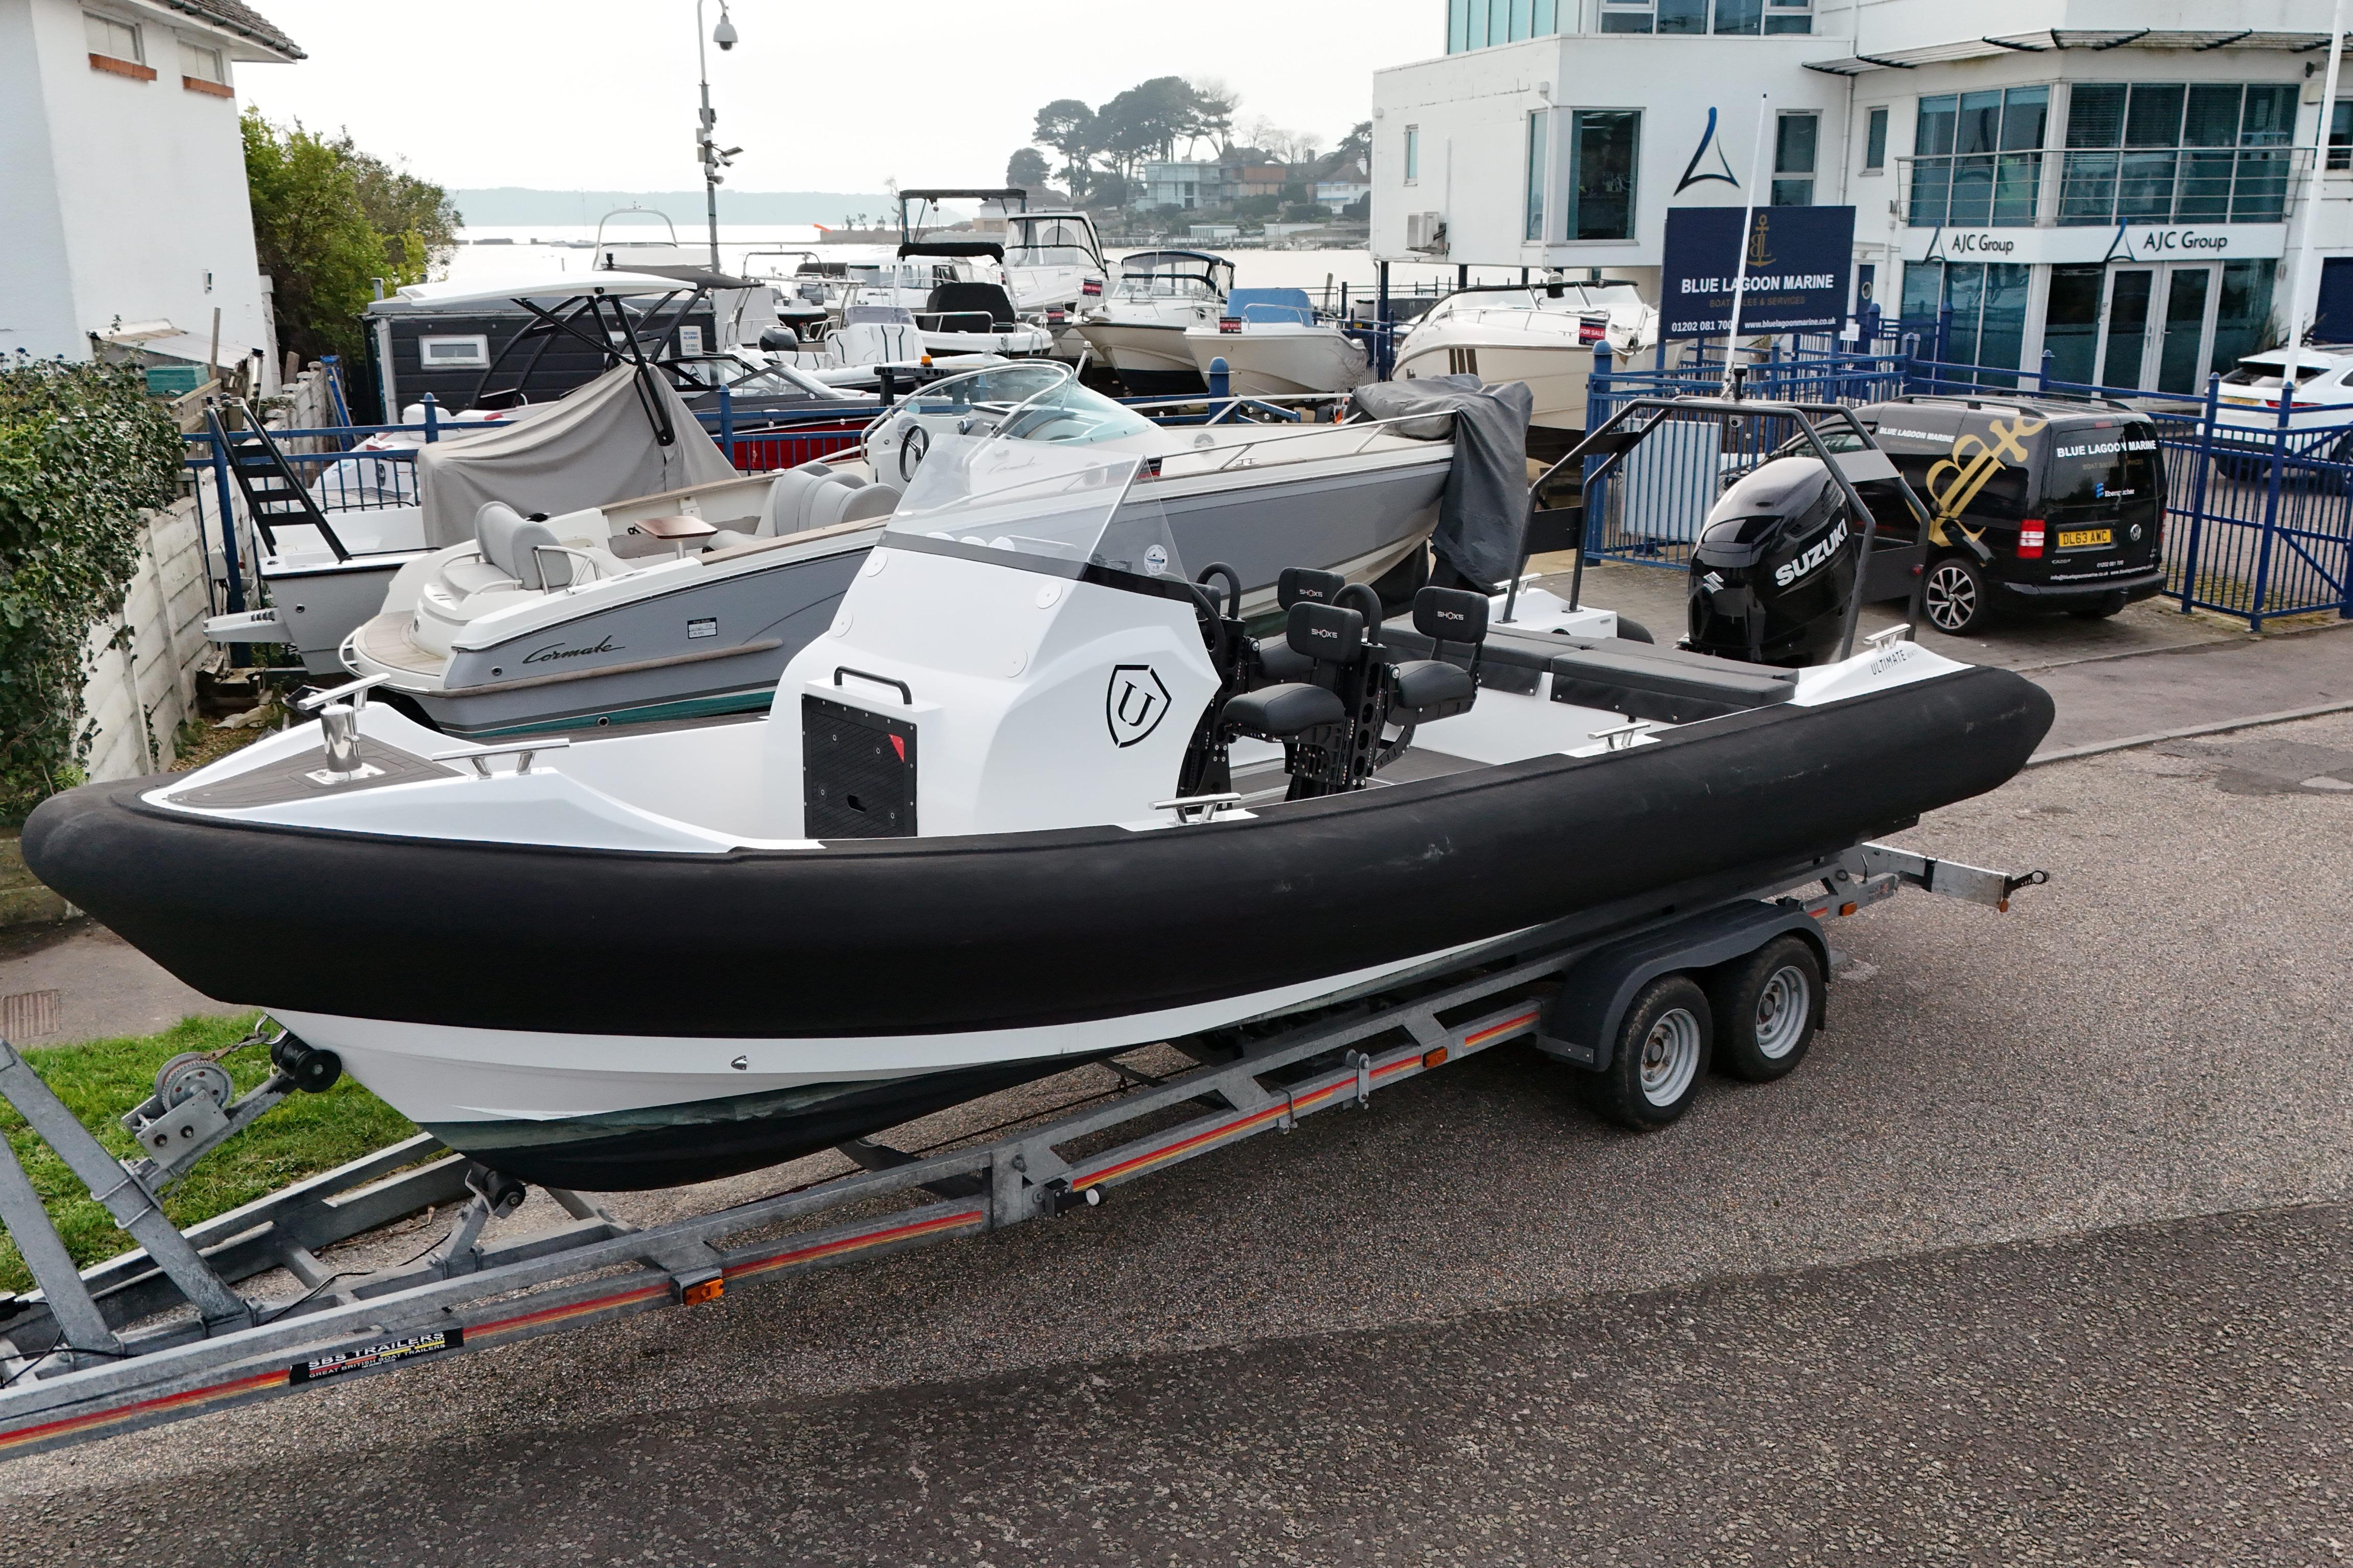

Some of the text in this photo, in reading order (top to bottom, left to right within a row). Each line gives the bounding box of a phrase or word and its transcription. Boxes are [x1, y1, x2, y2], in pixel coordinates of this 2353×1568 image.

[1952, 234, 2014, 255] AJC Group
[2143, 231, 2228, 252] AJC Group
[1681, 274, 1835, 294] BLUE LAGOON MARINE
[1709, 299, 1730, 308] BOAT
[1767, 296, 1805, 306] SERVICES
[1671, 322, 1698, 332] 01202
[1699, 321, 1715, 331] 081
[1745, 317, 1836, 328] www.bluelagoonmarine.co.uk
[1879, 427, 1955, 443] BLUE LAGOON MARINE
[2057, 445, 2086, 457] BLUE
[2129, 440, 2156, 451] MARINE
[2063, 530, 2107, 545] DL63 AWC
[1775, 518, 1848, 586] SUZUKI
[1299, 589, 1323, 597] SHOXS
[1437, 611, 1464, 620] SHOXS
[1311, 629, 1338, 638] SHOXS
[1870, 649, 1906, 675] ULTIMATE
[308, 1354, 347, 1368] SBS
[352, 1332, 445, 1357] TRAILERS
[308, 1367, 338, 1378] GREAT
[341, 1359, 376, 1370] BRITISH
[378, 1353, 401, 1362] BOAT
[404, 1343, 446, 1356] TRAILERS
